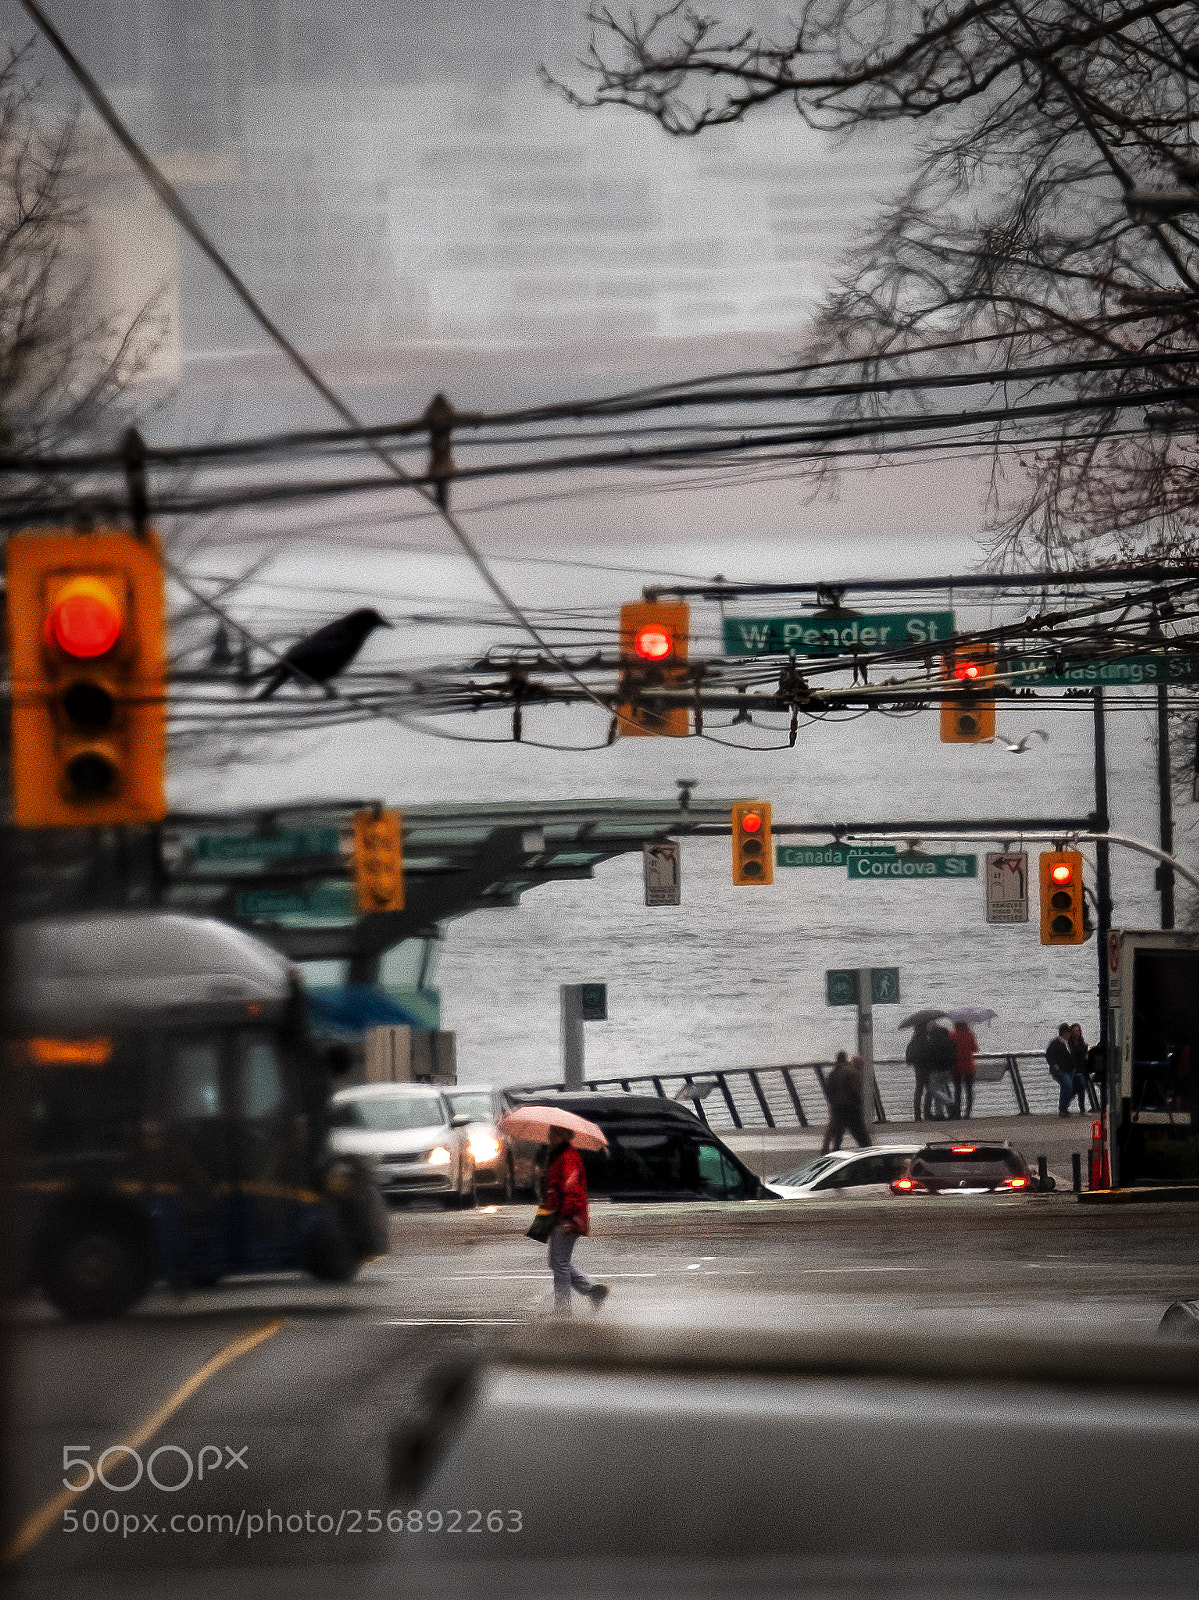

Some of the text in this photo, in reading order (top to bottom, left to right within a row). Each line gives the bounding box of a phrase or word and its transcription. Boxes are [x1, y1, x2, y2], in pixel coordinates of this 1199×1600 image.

[738, 618, 938, 649] W Pender St
[784, 848, 843, 865] Canada
[856, 857, 968, 876] Cordova St
